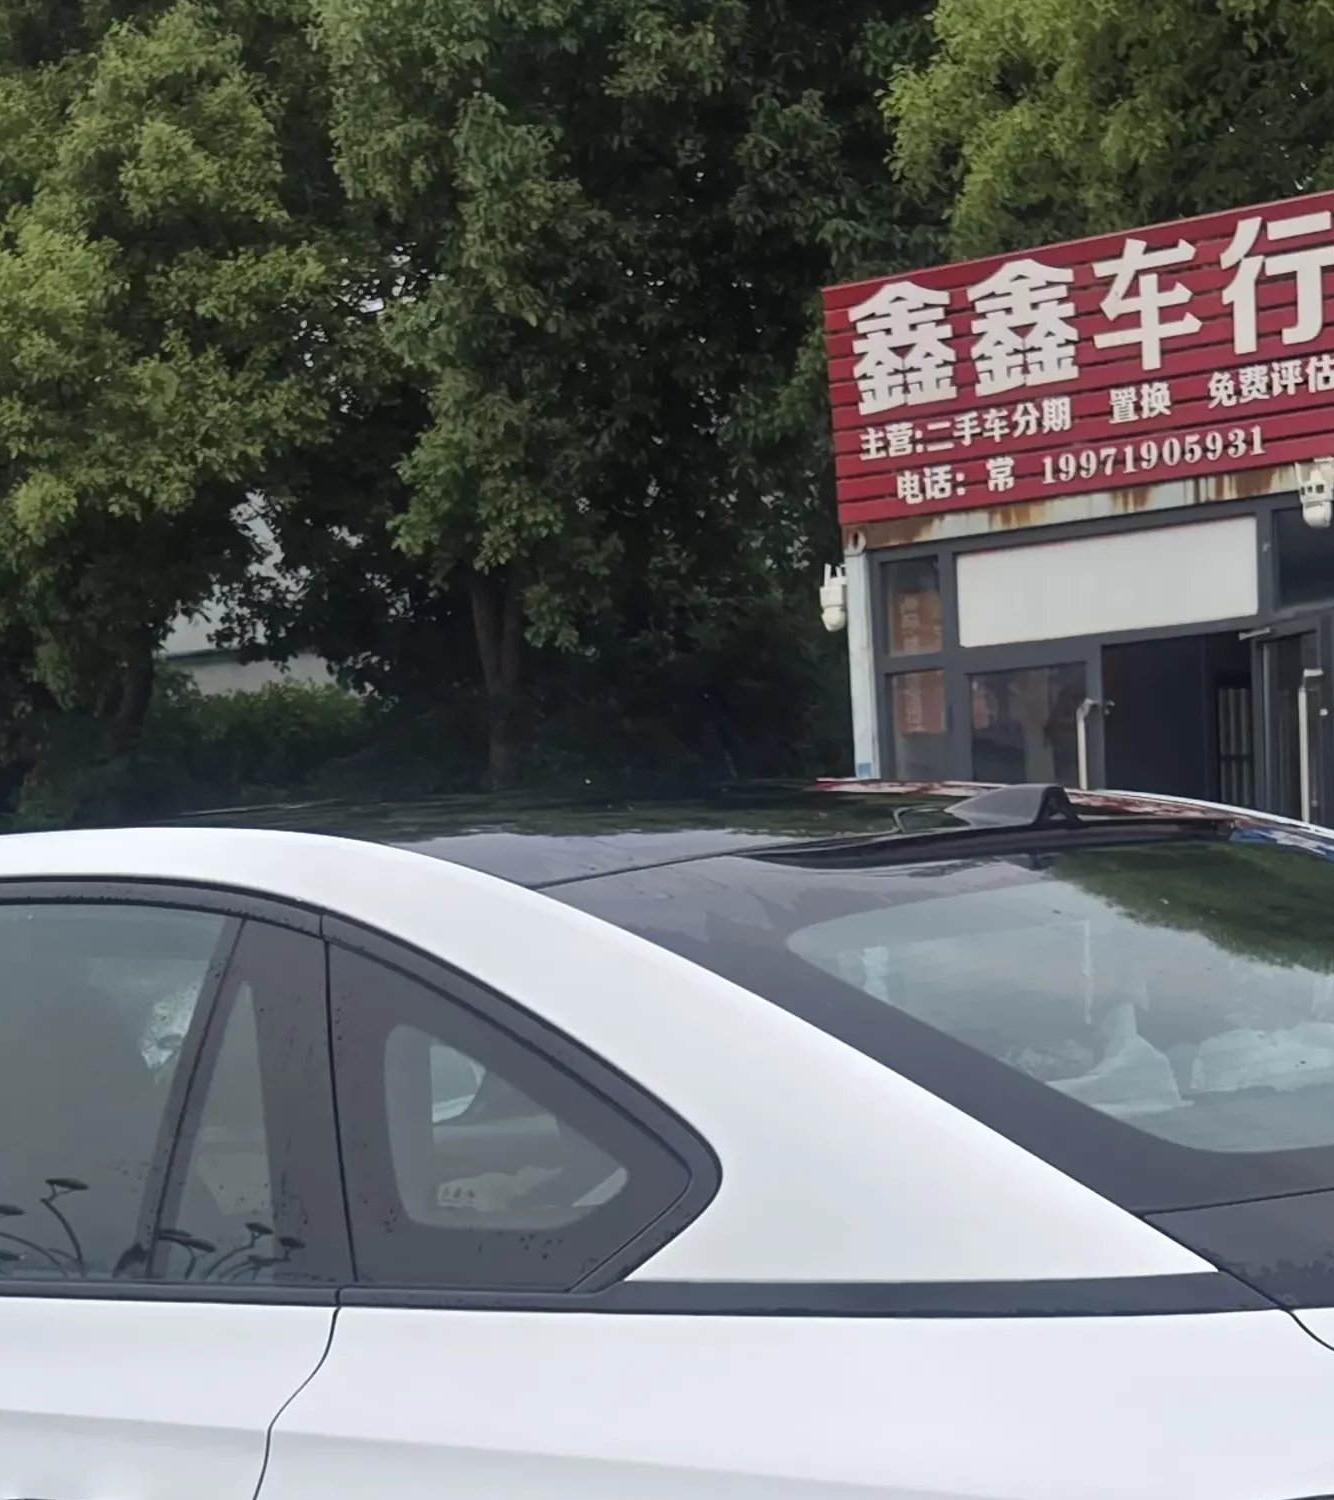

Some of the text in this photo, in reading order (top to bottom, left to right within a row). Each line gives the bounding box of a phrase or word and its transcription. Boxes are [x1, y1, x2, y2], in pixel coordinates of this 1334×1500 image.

[1108, 381, 1173, 425] 置换
[895, 424, 1267, 506] 电话： 常 19971905931
